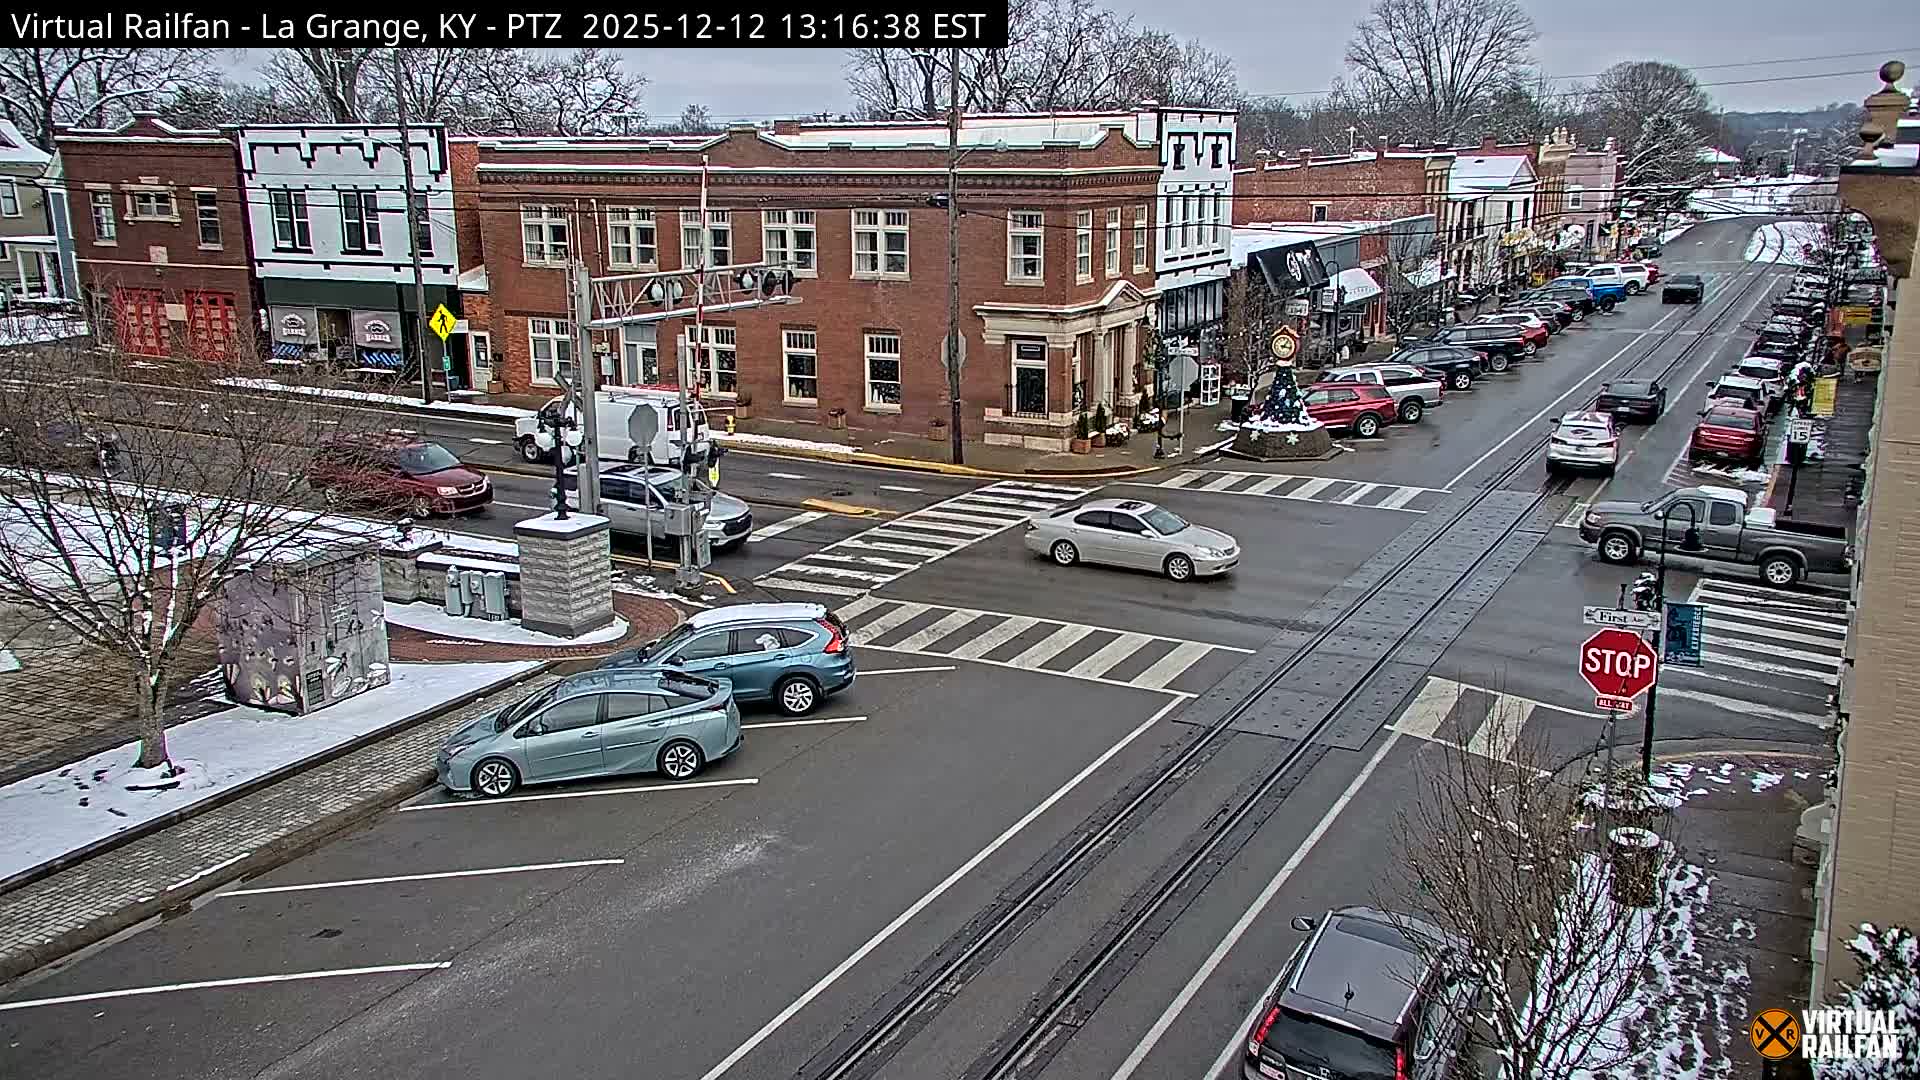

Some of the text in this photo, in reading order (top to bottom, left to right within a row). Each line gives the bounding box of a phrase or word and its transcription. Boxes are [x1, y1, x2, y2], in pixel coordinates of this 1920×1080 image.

[1793, 431, 1808, 441] 15
[1599, 611, 1627, 623] First
[1585, 647, 1651, 679] STOP
